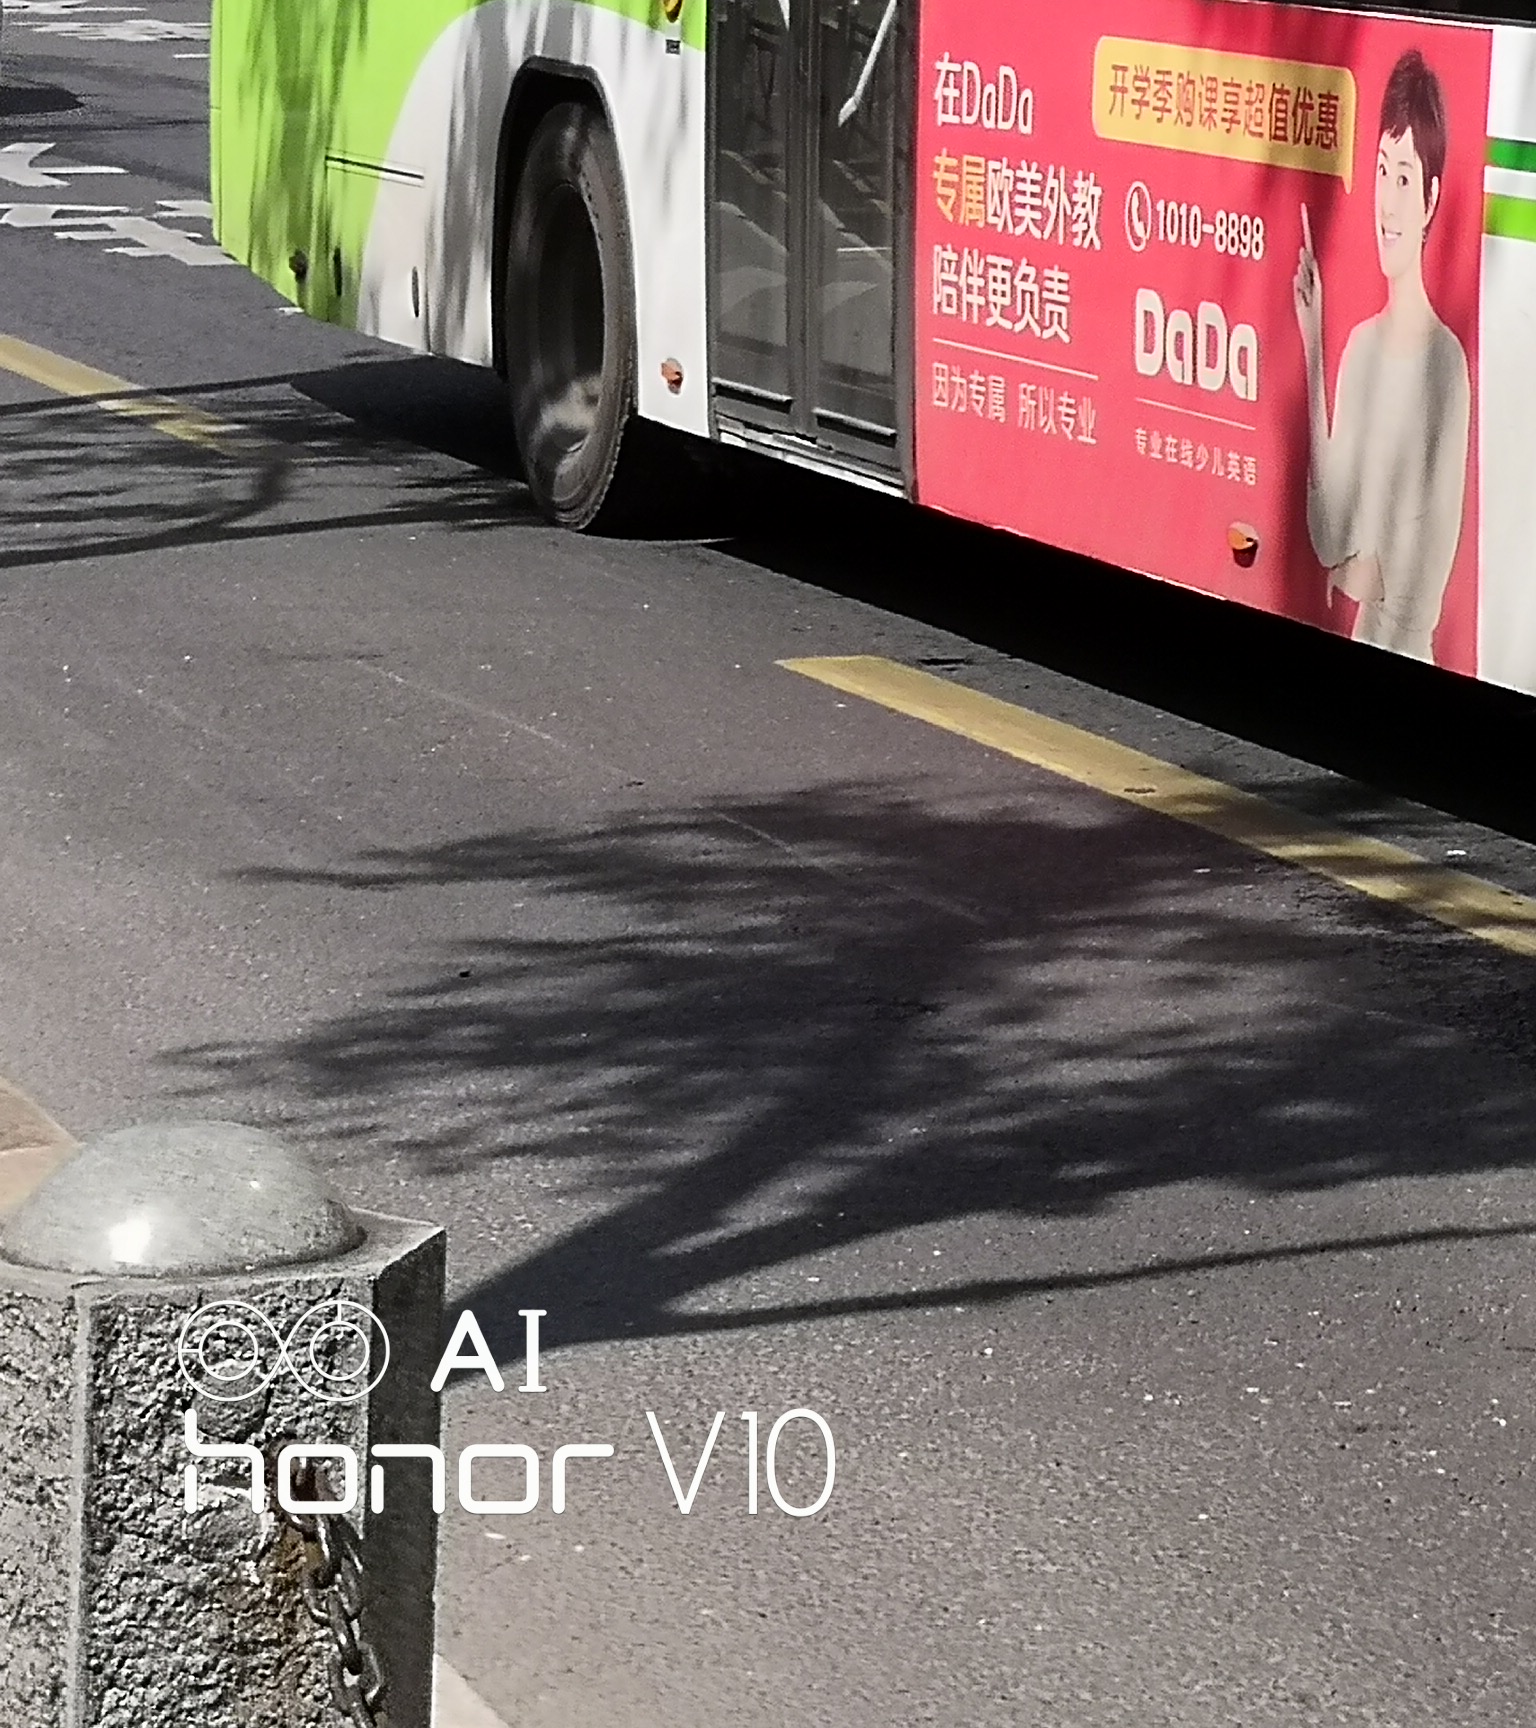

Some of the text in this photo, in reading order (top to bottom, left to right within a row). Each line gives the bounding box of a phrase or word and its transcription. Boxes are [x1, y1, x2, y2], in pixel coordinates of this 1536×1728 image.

[935, 52, 1033, 135] 在DaDa
[1109, 64, 1339, 150] 开学季购课享超值优惠
[932, 148, 1102, 251] 专属欧美外教
[1155, 198, 1265, 261] 1010-8898
[932, 244, 1071, 344] 陪伴更负责
[1135, 287, 1258, 402] DaDa
[932, 362, 1097, 445] 因为专属 所以专业
[1135, 426, 1257, 486] 专业在线少儿英语
